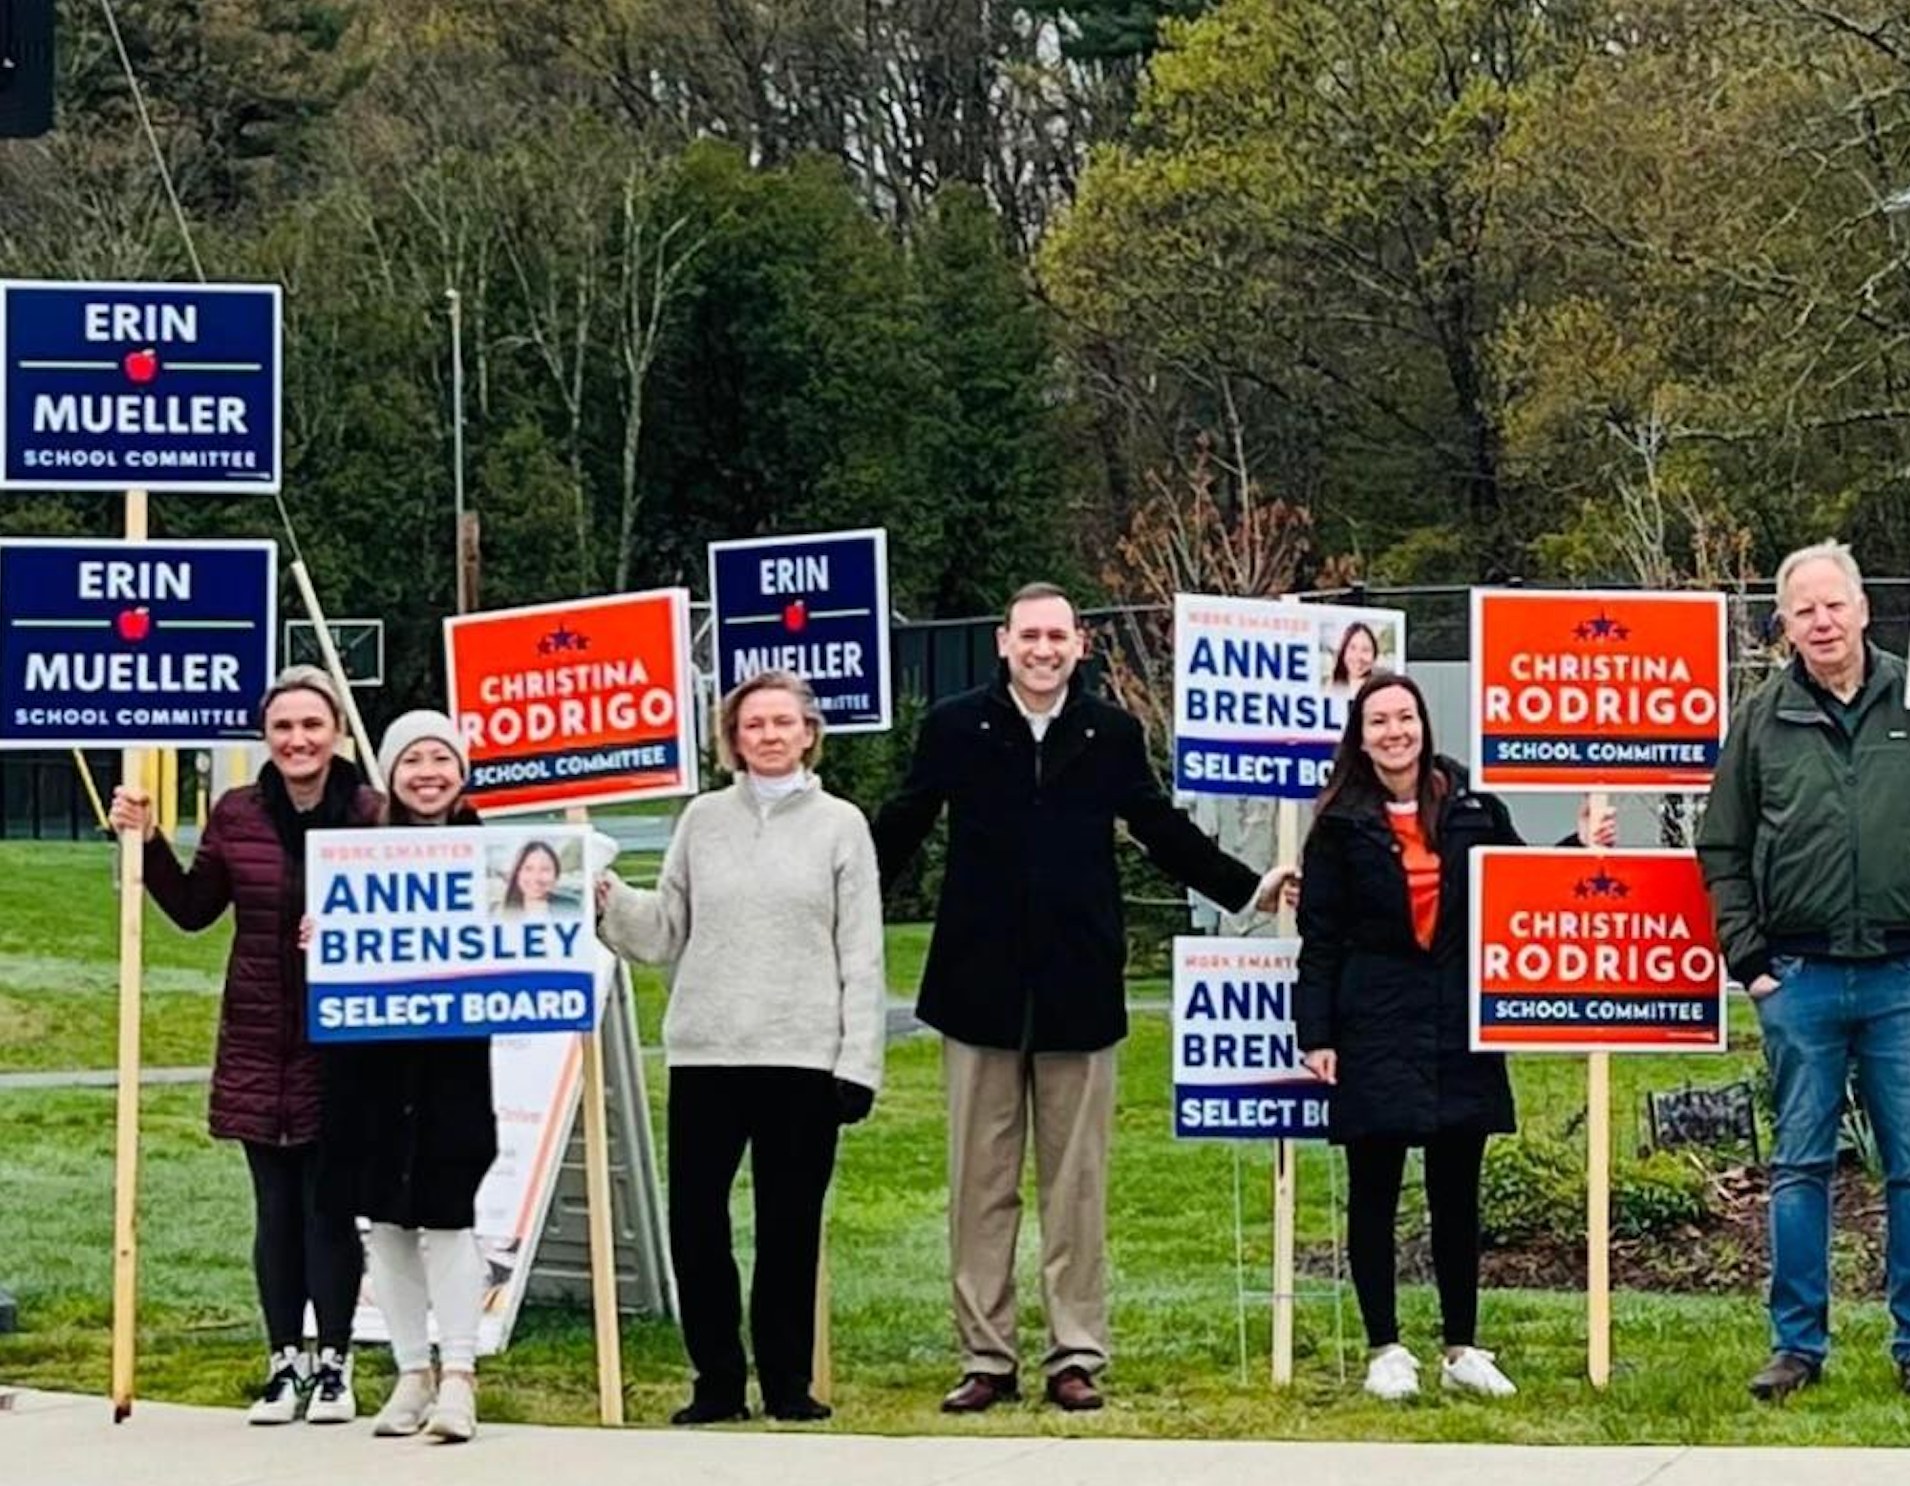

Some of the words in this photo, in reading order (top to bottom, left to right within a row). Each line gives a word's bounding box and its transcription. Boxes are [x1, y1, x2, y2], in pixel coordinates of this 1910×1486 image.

[85, 303, 197, 342] ERIN
[33, 394, 248, 434] MUELLER
[24, 450, 117, 467] SCHOOL
[125, 450, 256, 468] COMMITTEE
[78, 561, 191, 600] ERIN
[759, 554, 829, 595] ERIN
[24, 653, 241, 693] MUELLER
[1188, 636, 1310, 682] ANNE
[1510, 653, 1692, 683] CHRISTINA
[480, 657, 649, 704] CHRISTINA
[14, 708, 109, 725] SCHOOL
[117, 708, 248, 726] COMMITTEE
[461, 687, 675, 748] RODRIGO
[1186, 688, 1349, 731] BRENSL
[1485, 685, 1717, 725] RODRIGO
[474, 761, 550, 787] SCHOOL
[555, 746, 666, 776] COMMITTEE
[1183, 751, 1292, 785] SELECT
[1497, 742, 1582, 761] SCHOOL
[1587, 743, 1705, 762] COMMITTEE
[321, 870, 475, 915] ANNE
[320, 922, 582, 965] BRENSLEY
[1509, 911, 1691, 939] CHRISTINA
[1237, 955, 1298, 970] SMART
[1483, 942, 1716, 982] RODRIGO
[318, 993, 454, 1028] SELECT
[461, 989, 587, 1024] BOARD
[1495, 1000, 1579, 1019] SCHOOL
[1585, 1001, 1704, 1021] COMMITTEE
[1181, 1098, 1297, 1127] SELECT
